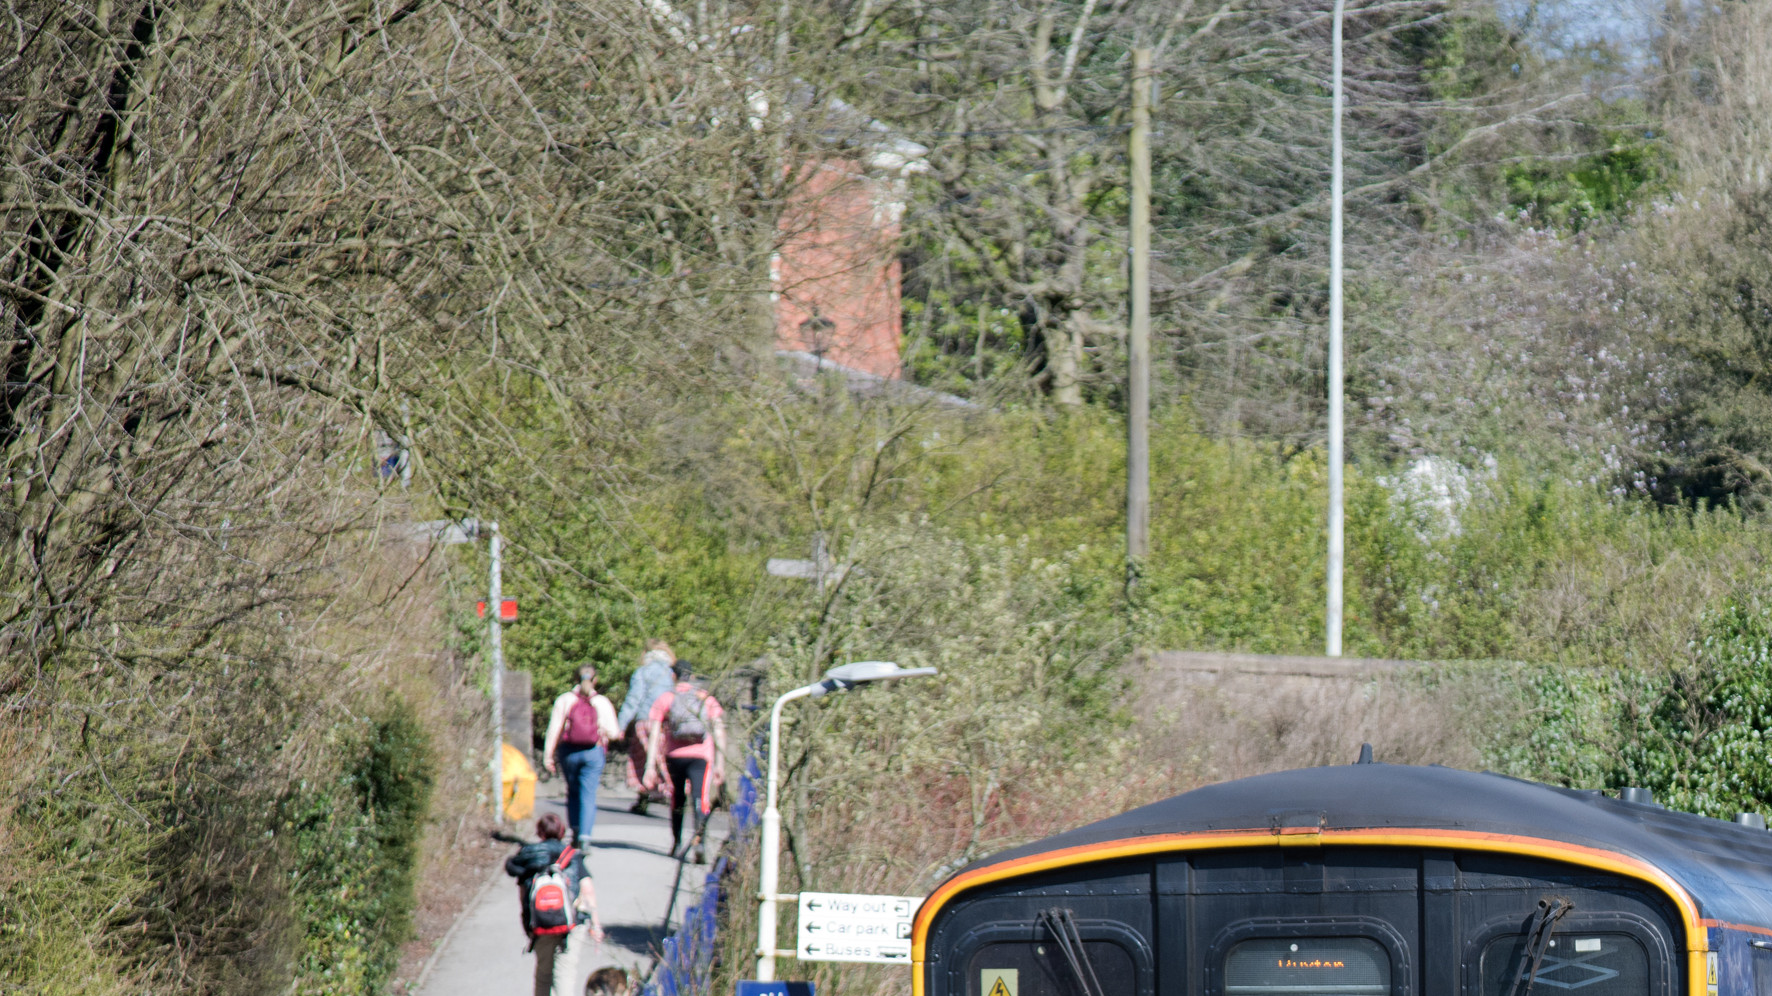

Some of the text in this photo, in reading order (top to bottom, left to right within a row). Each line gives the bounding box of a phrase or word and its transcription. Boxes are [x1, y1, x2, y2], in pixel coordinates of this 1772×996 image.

[828, 899, 887, 914] Way out
[826, 921, 852, 933] Car
[856, 923, 889, 936] park
[826, 943, 871, 956] Buses
